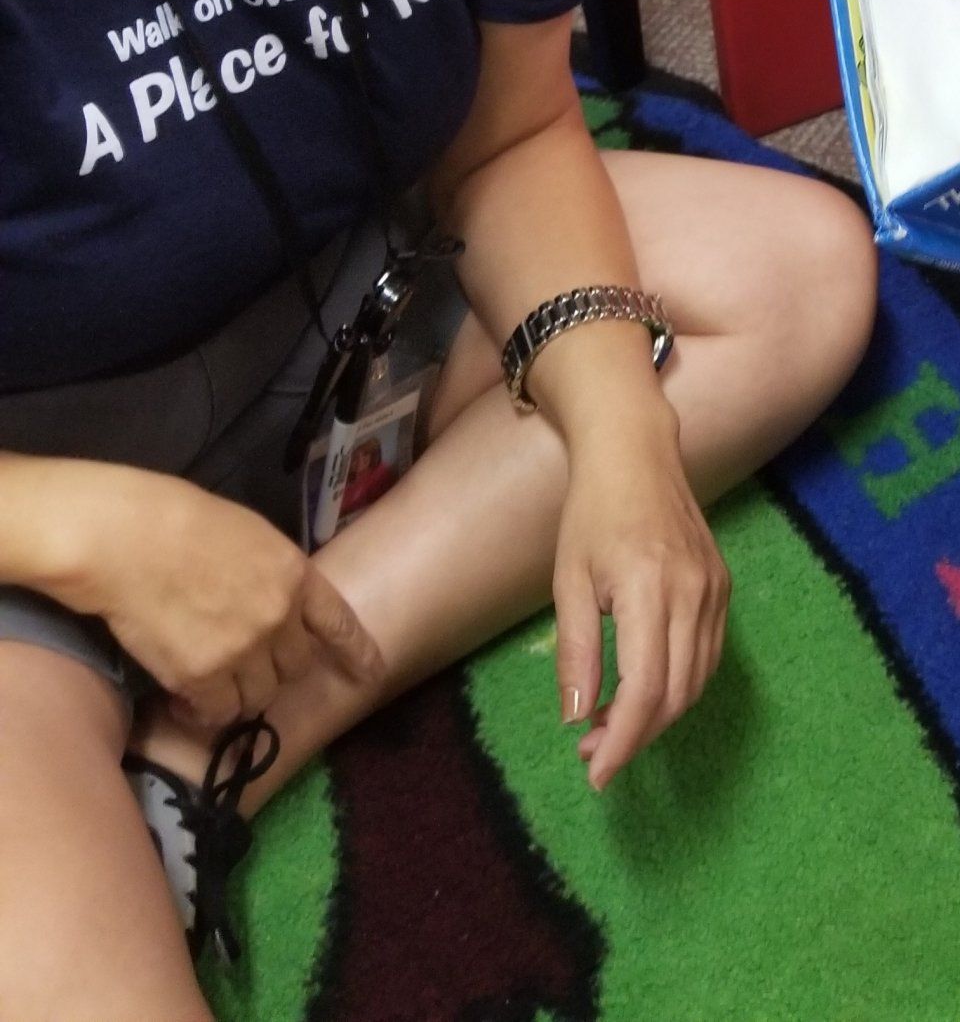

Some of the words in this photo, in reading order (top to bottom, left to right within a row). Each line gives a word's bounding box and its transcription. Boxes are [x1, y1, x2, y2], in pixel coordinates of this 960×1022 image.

[107, 2, 183, 62] Walk
[78, 102, 124, 176] A
[129, 33, 287, 144] Place
